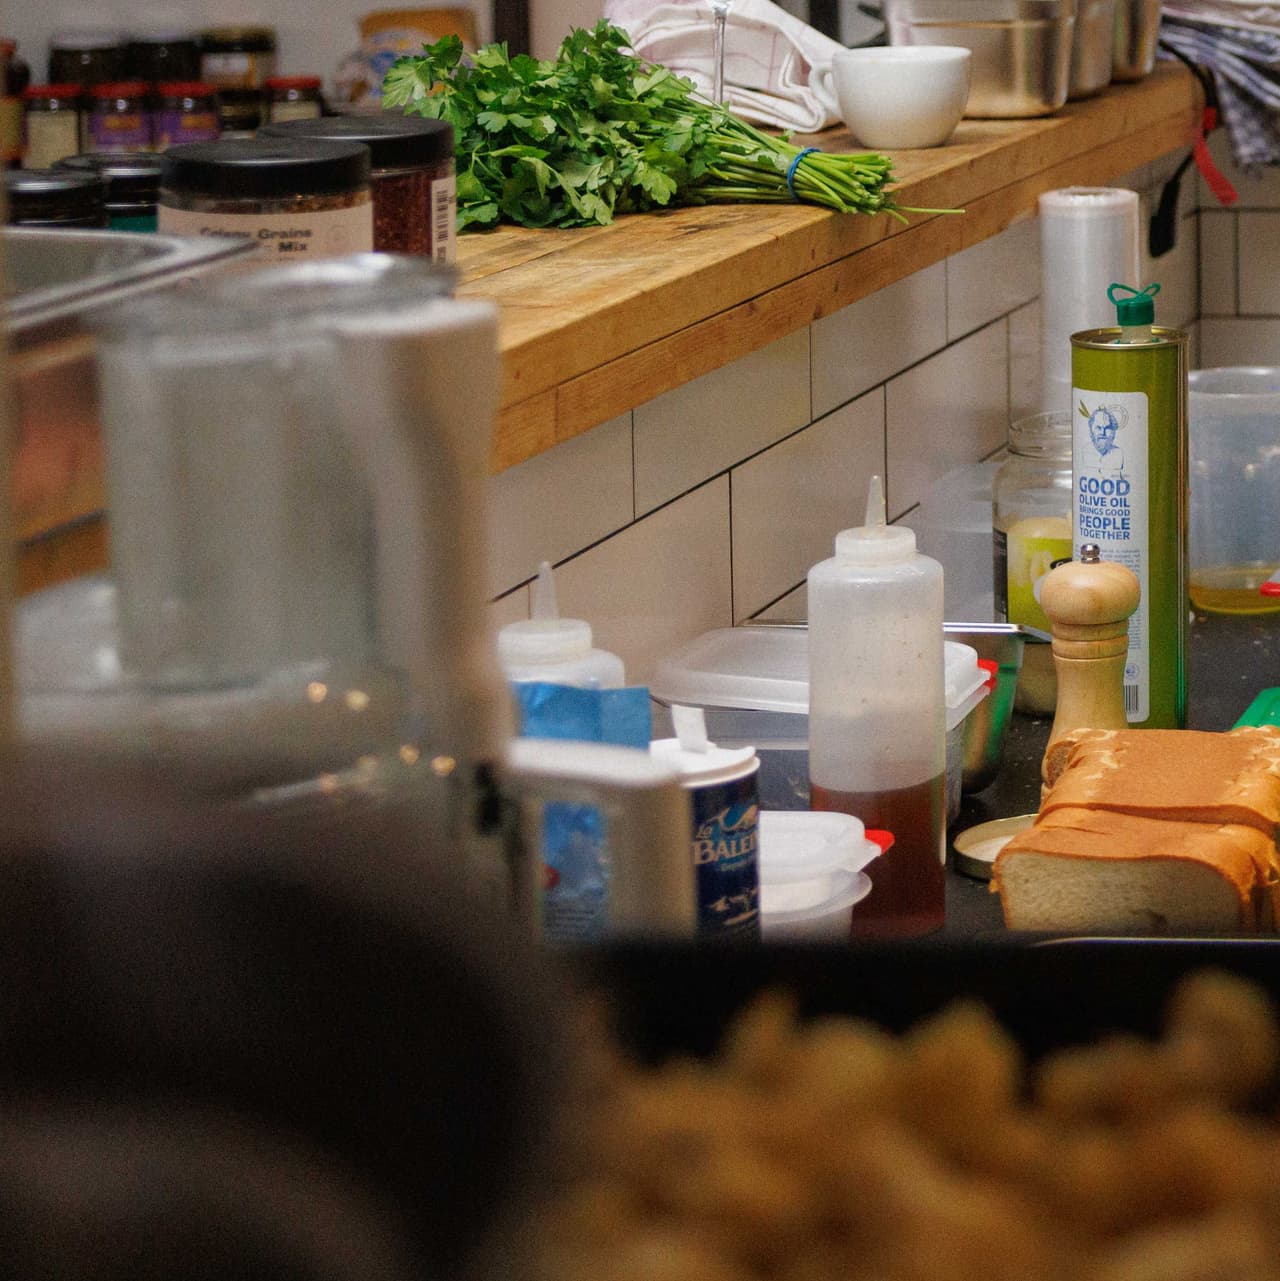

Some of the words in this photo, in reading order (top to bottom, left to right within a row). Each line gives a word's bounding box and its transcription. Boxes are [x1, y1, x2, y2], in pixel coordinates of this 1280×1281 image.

[258, 227, 312, 239] Grains
[278, 240, 307, 253] Mix
[1079, 476, 1130, 496] GOOD
[1079, 494, 1107, 507] OLIVE
[1110, 497, 1130, 507] OIL
[1079, 504, 1104, 516] BRINGS
[1105, 508, 1130, 517] GOOD
[1079, 513, 1130, 531] PEOPLE
[1079, 526, 1130, 541] TOGETHER
